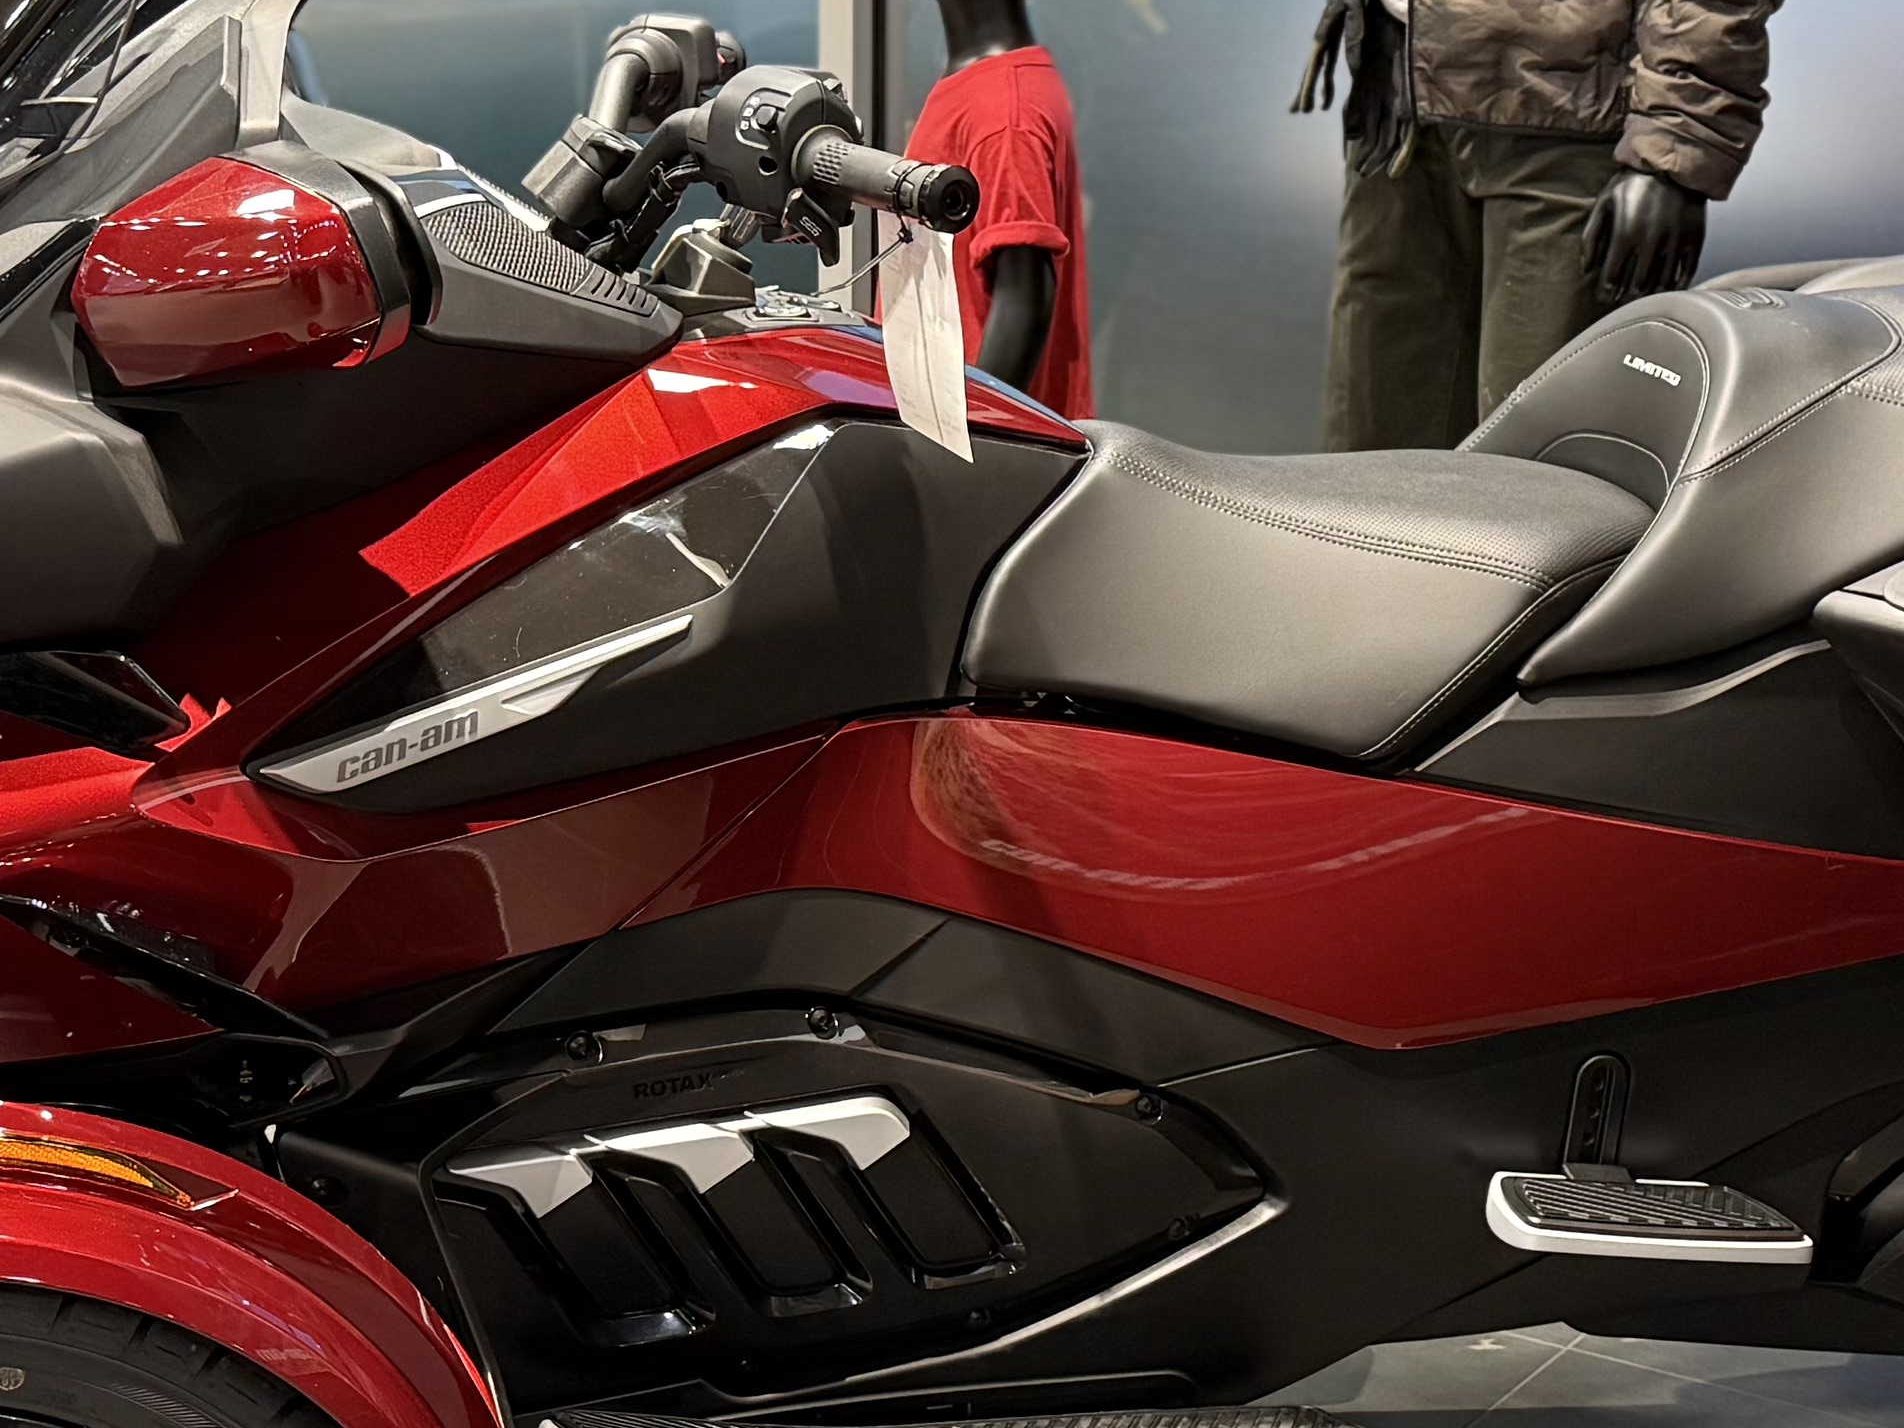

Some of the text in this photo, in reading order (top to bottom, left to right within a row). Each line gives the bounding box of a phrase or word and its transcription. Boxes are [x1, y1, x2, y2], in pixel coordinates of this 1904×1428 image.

[1623, 352, 1682, 387] LIMITED
[334, 709, 480, 785] can-am
[633, 1072, 715, 1100] ROTAX
